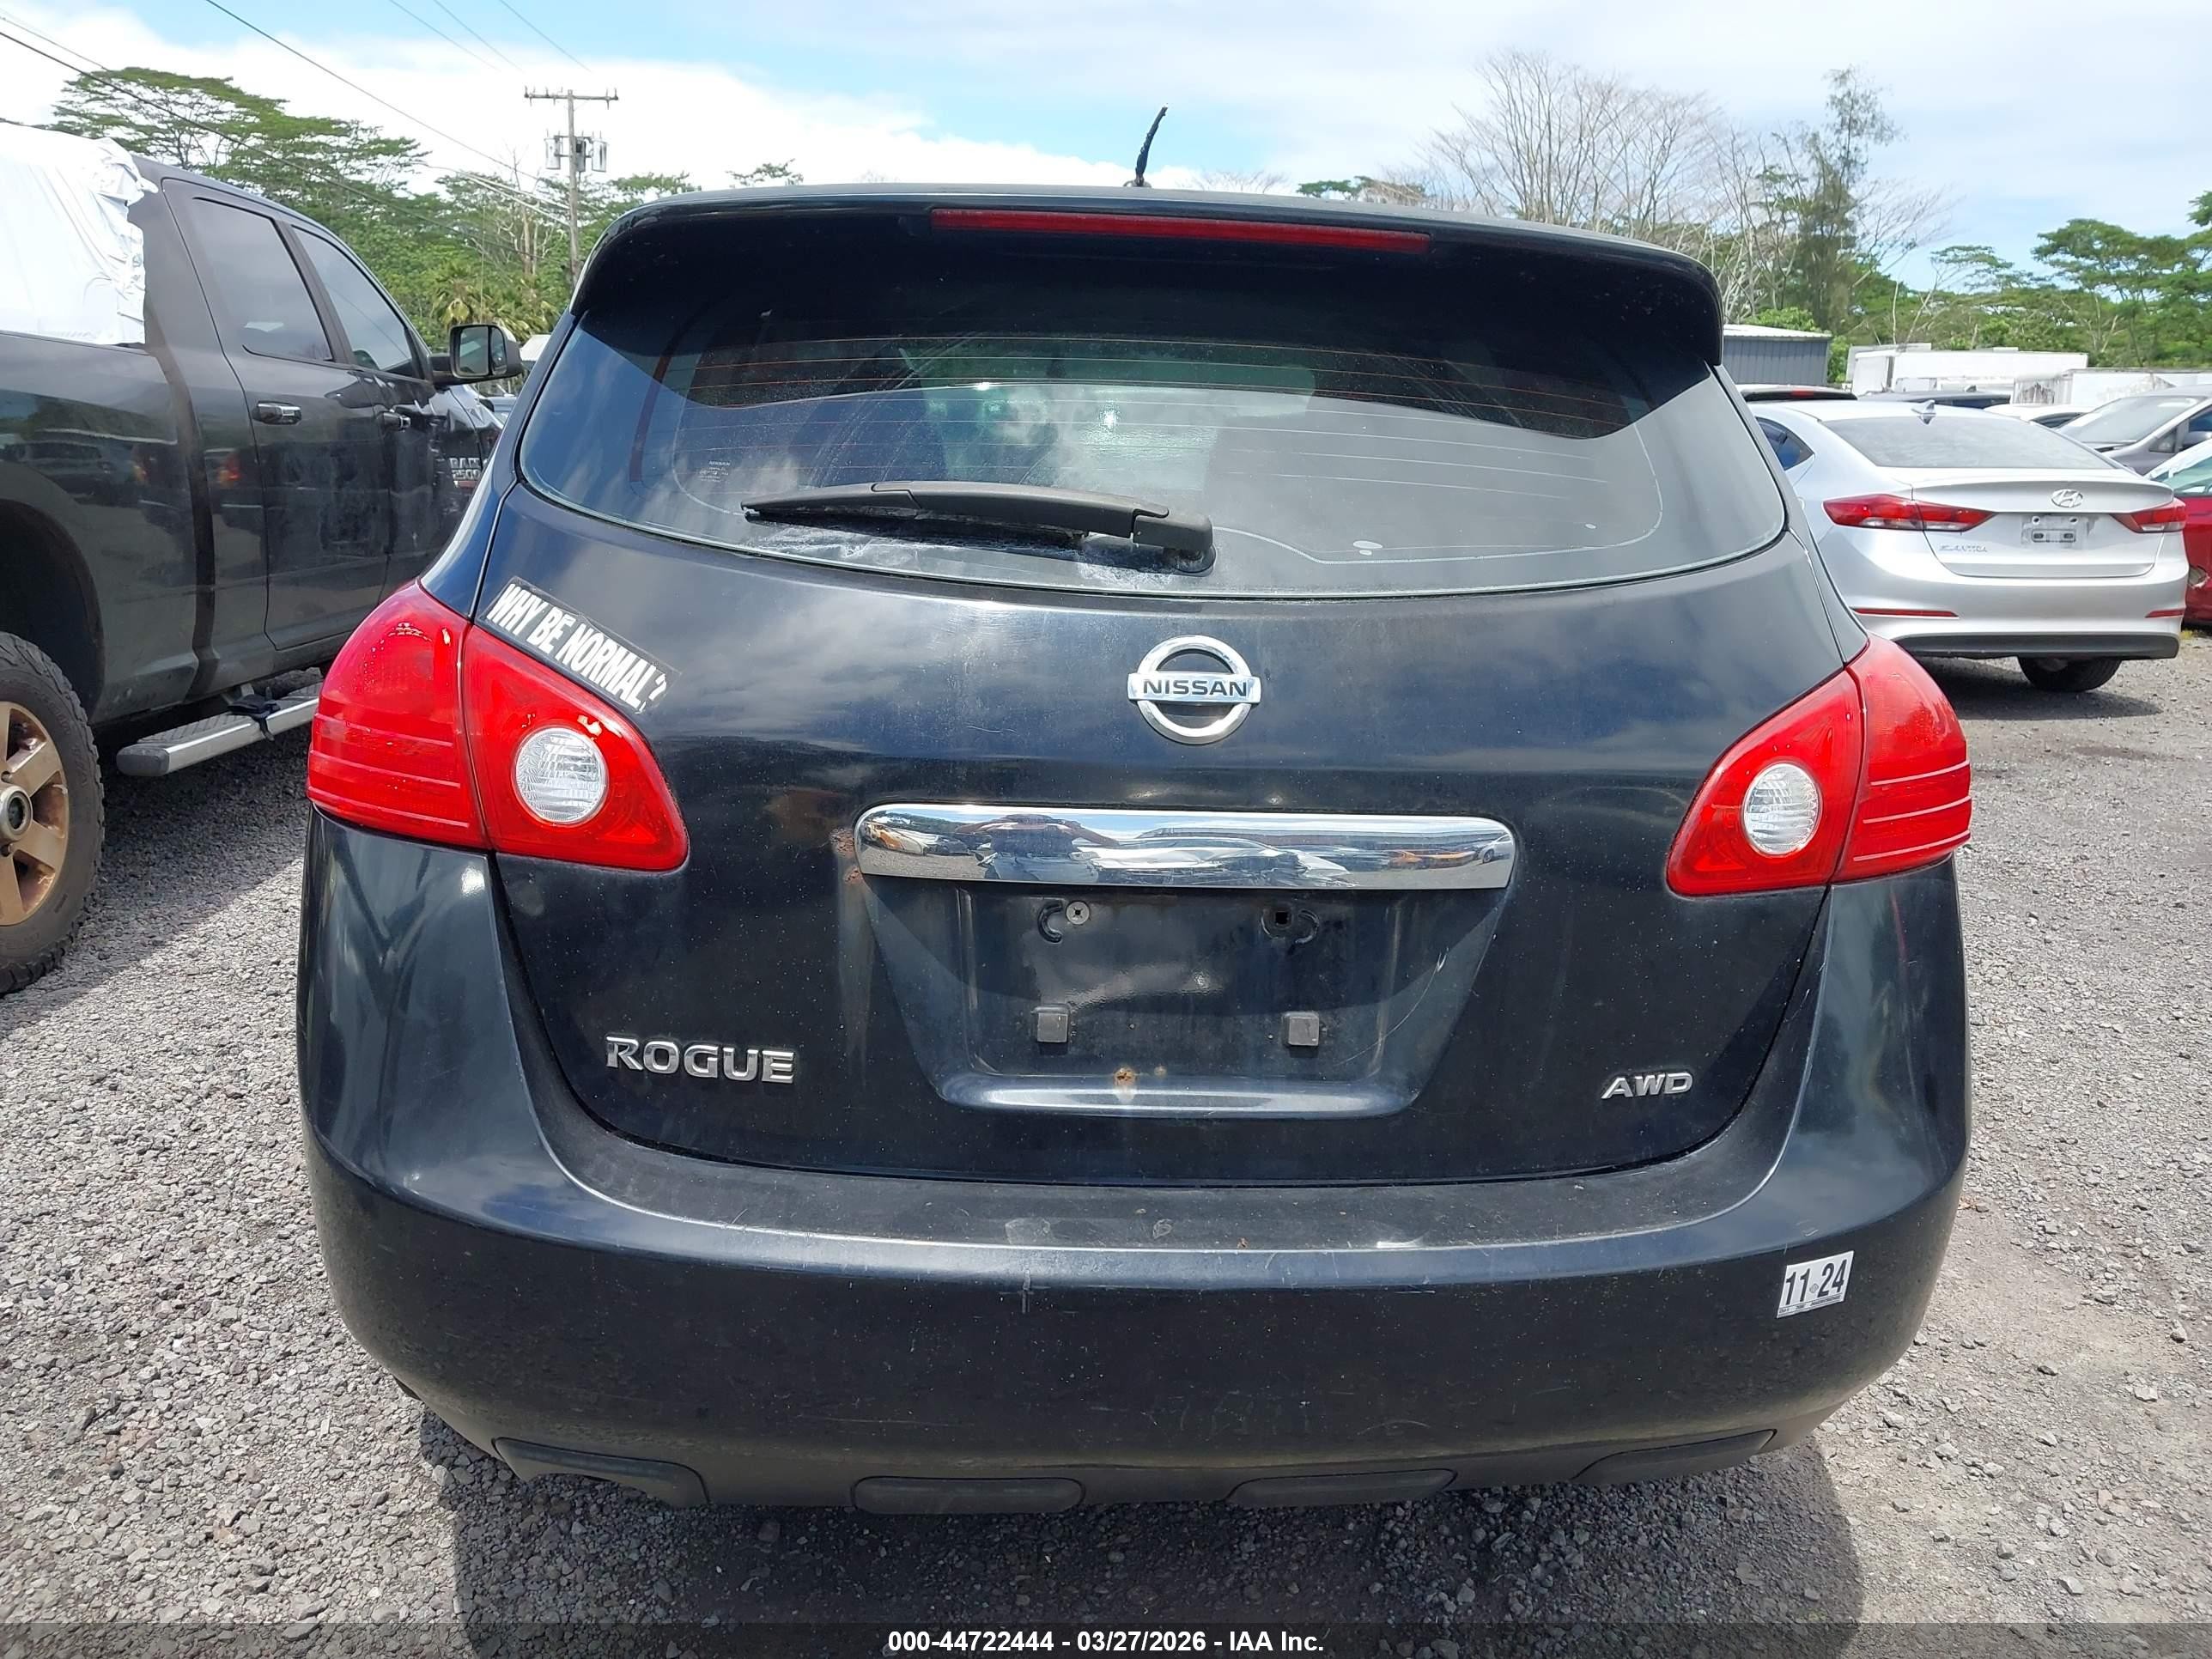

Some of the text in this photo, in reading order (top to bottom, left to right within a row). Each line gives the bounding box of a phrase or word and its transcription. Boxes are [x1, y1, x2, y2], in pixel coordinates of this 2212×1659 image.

[486, 583, 667, 714] WHY BE NORMAL?
[1143, 679, 1247, 697] NISSAN
[605, 1036, 794, 1084] ROGUE
[1601, 1073, 1693, 1099] AWD
[1785, 1267, 1810, 1306] 11
[1817, 1259, 1848, 1297] 24
